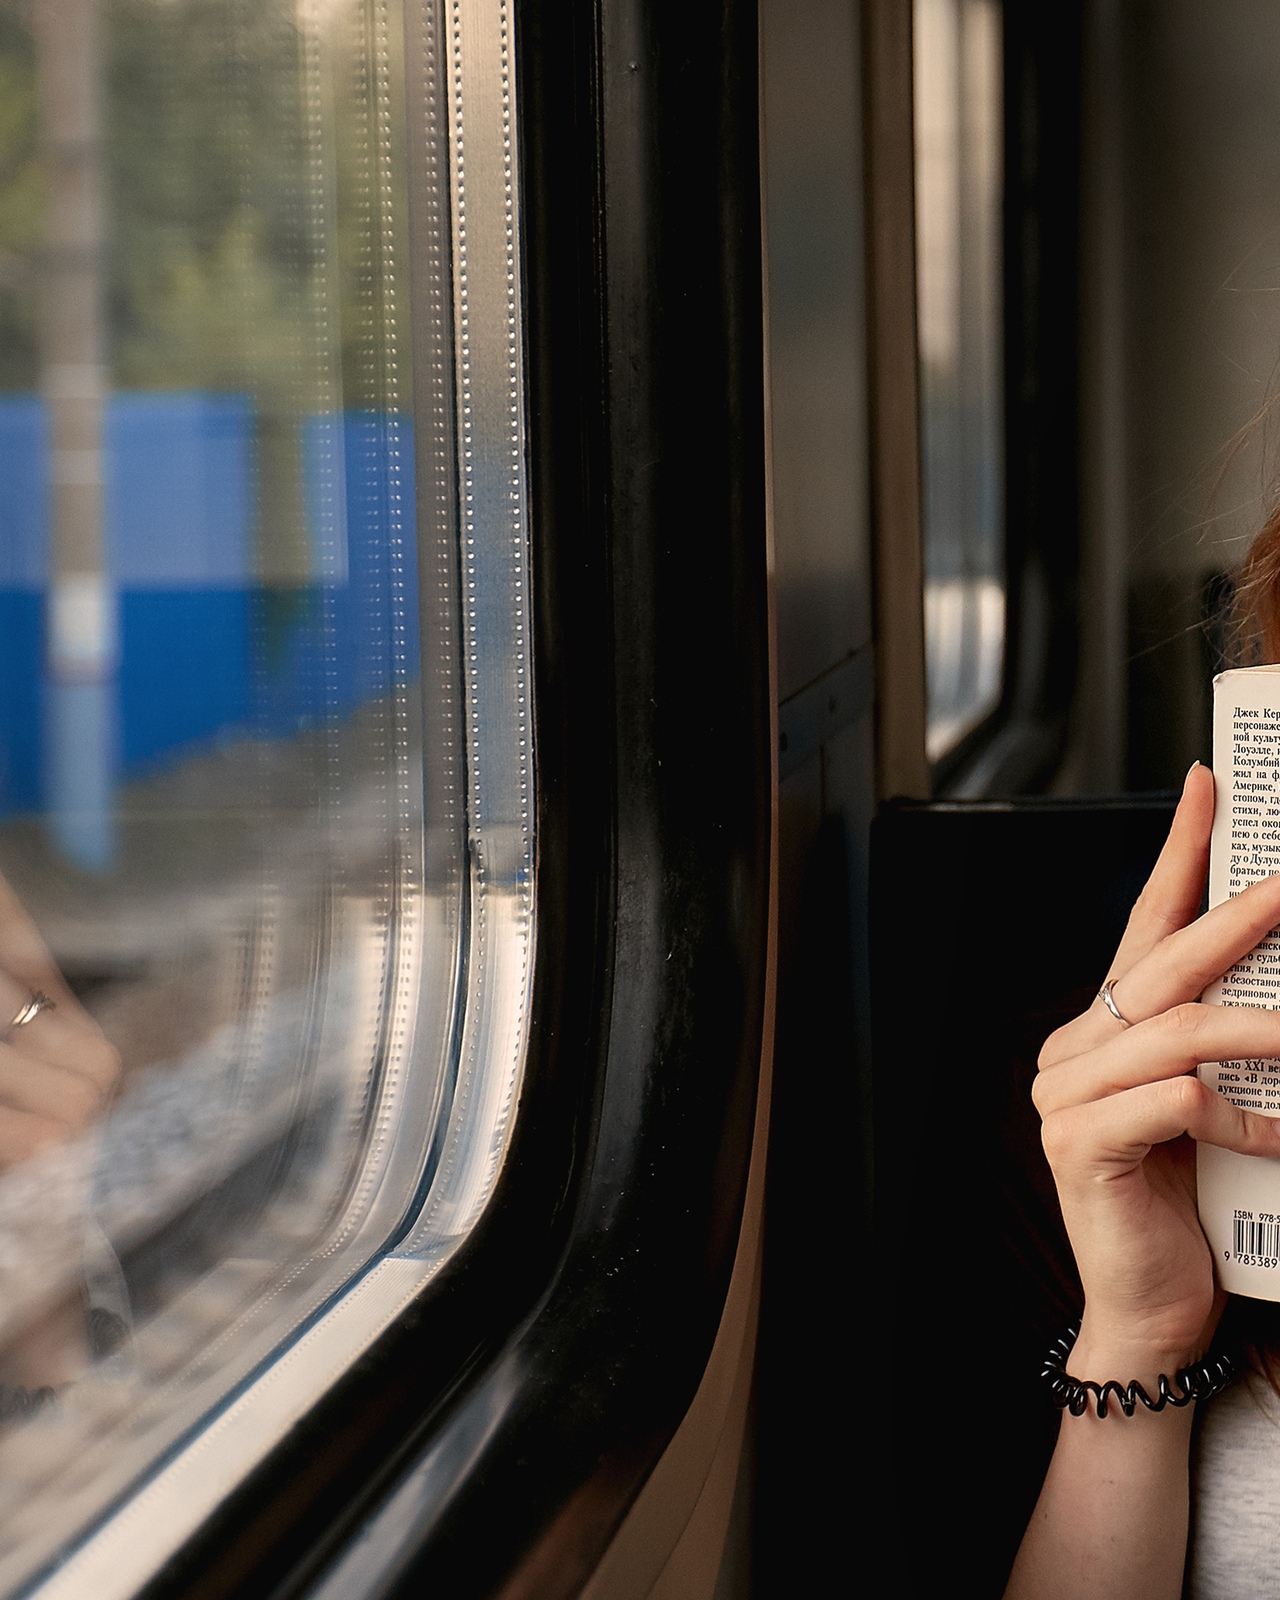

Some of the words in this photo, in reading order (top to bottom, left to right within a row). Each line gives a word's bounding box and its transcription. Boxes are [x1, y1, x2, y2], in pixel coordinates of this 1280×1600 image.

[1232, 707, 1259, 719] Джек
[1233, 731, 1249, 742] ной
[1232, 743, 1274, 758] Лоуэлле,
[1232, 769, 1251, 778] жил
[1256, 770, 1266, 779] на
[1232, 779, 1276, 794] Америке,
[1232, 793, 1267, 806] стопом,
[1232, 805, 1261, 817] стихи,
[1232, 818, 1258, 829] успел
[1231, 830, 1250, 840] пею
[1252, 831, 1258, 840] о
[1231, 842, 1250, 853] ках,
[1230, 854, 1241, 865] ду
[1230, 864, 1266, 877] братьев
[1229, 878, 1240, 887] но
[1246, 952, 1254, 961] о
[1228, 964, 1254, 976] ения,
[1221, 974, 1228, 983] в
[1221, 987, 1276, 1000] зедриновом
[1217, 1060, 1241, 1070] чало
[1218, 1073, 1240, 1083] пись
[1244, 1074, 1258, 1084] «В
[1217, 1085, 1262, 1097] аукционе
[1234, 1210, 1254, 1220] ISBN
[1224, 1251, 1230, 1260] 9
[1237, 1254, 1278, 1268] 785389
